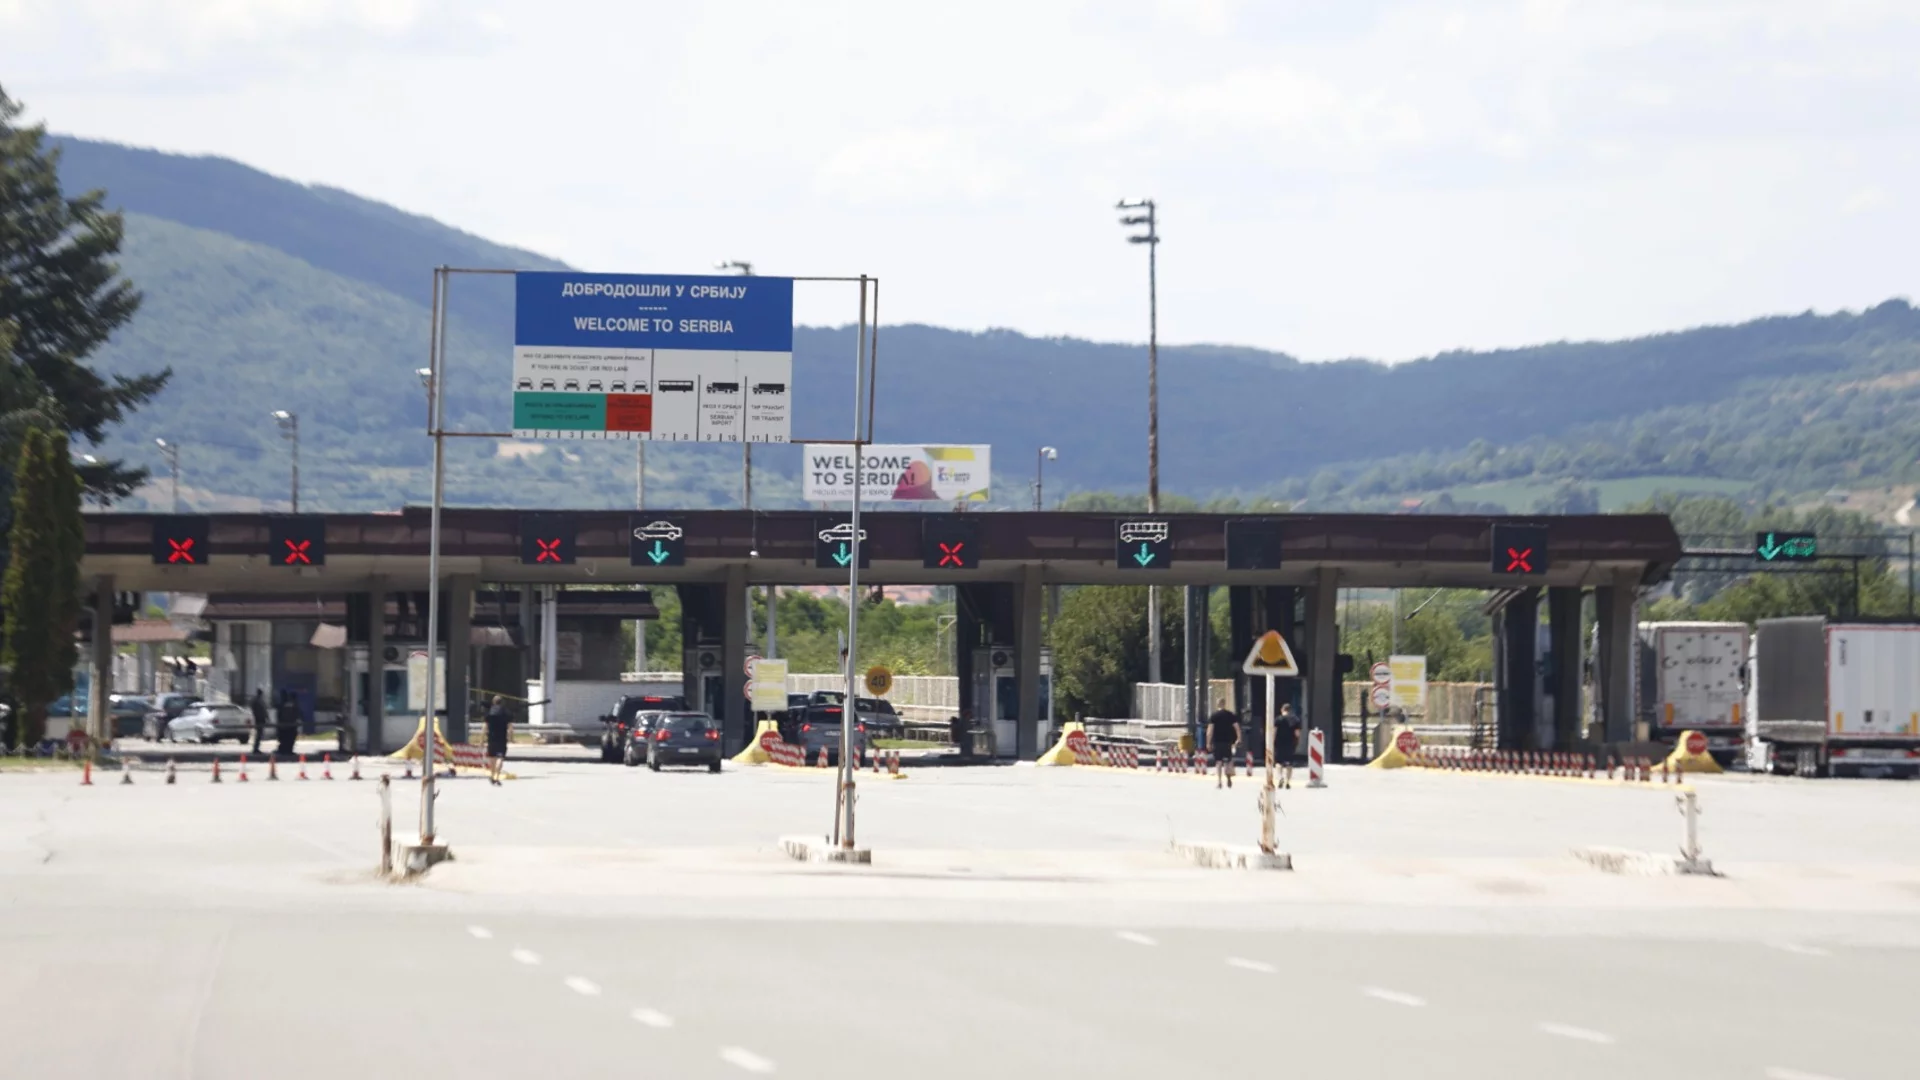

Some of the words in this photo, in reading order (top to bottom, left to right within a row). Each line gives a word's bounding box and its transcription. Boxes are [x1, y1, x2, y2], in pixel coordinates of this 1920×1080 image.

[562, 283, 671, 297] ДОБРОДОШЛИ
[676, 285, 685, 298] У
[690, 285, 747, 299] СРБИЈУ
[574, 317, 649, 332] WELCOME
[652, 318, 673, 333] TO
[679, 319, 734, 334] SERBIA
[812, 472, 837, 486] TO
[871, 675, 886, 687] 40
